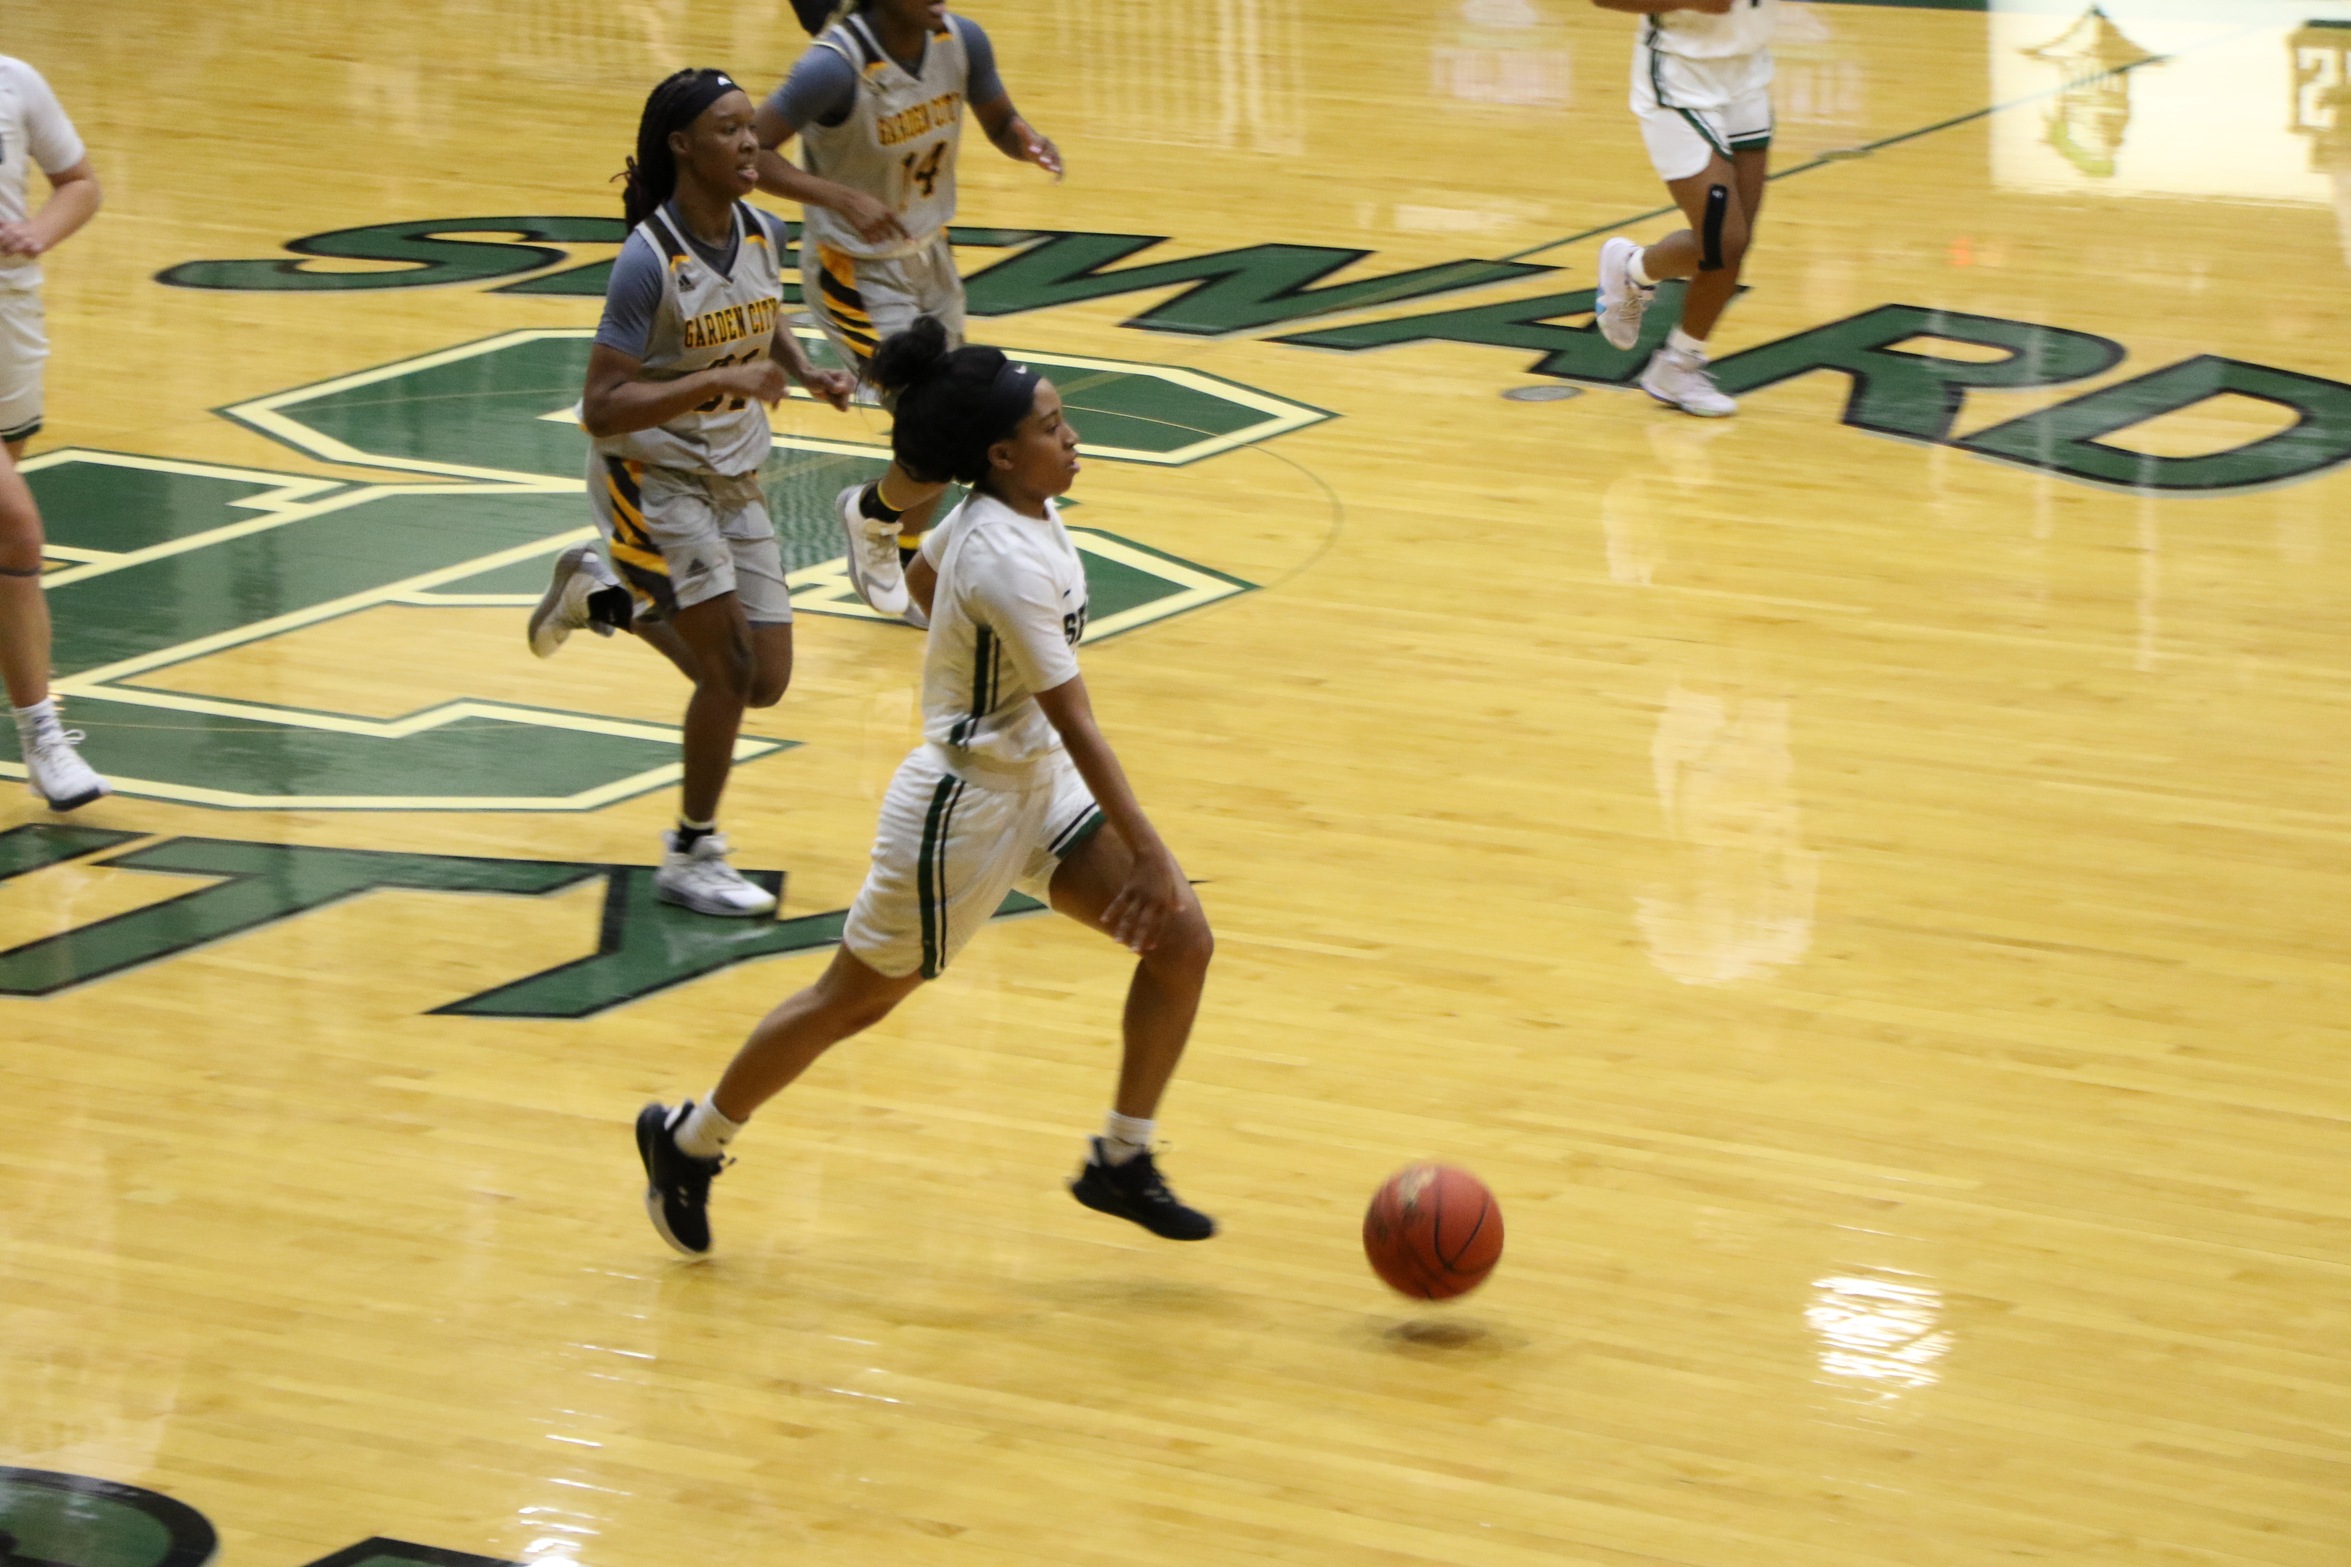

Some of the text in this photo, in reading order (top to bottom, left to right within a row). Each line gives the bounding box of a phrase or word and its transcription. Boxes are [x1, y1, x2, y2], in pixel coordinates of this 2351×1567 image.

[899, 141, 948, 213] 14
[684, 297, 777, 348] GARDEN CITY
